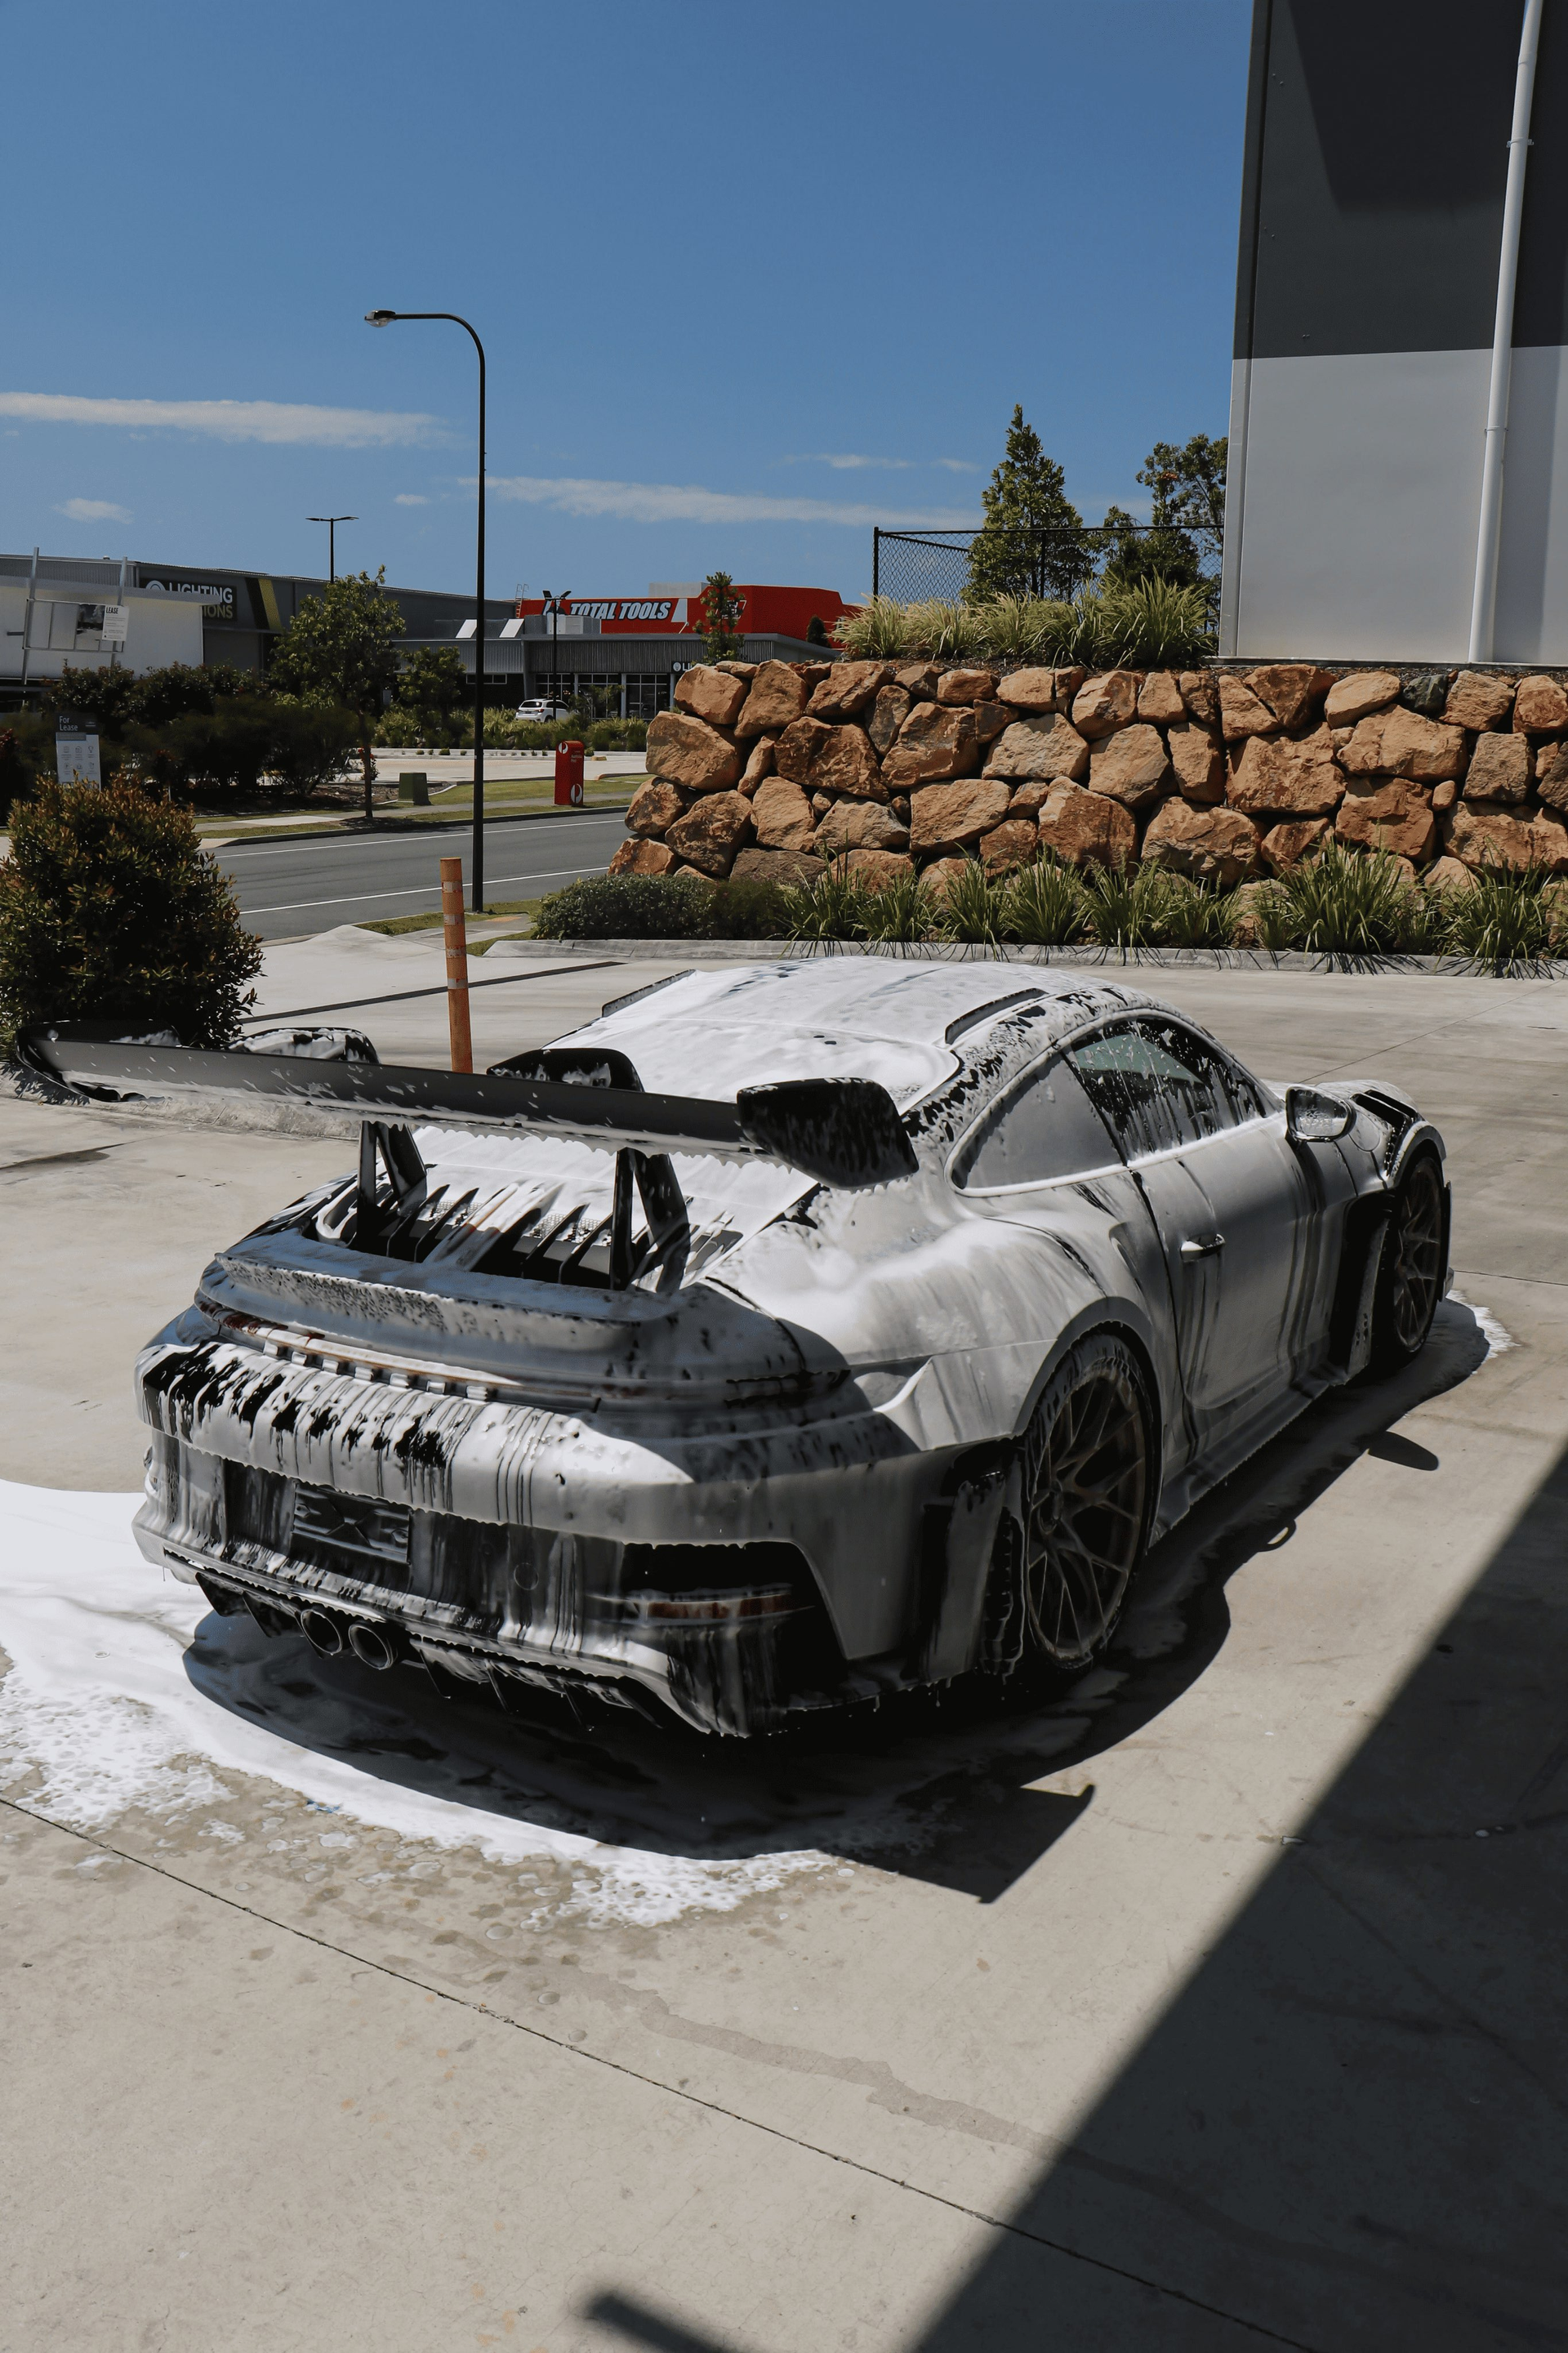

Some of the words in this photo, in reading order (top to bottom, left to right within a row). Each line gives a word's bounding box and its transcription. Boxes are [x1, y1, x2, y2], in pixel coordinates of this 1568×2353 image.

[570, 602, 617, 620] TOTAL
[619, 601, 671, 620] TOOLS
[59, 715, 69, 724] For
